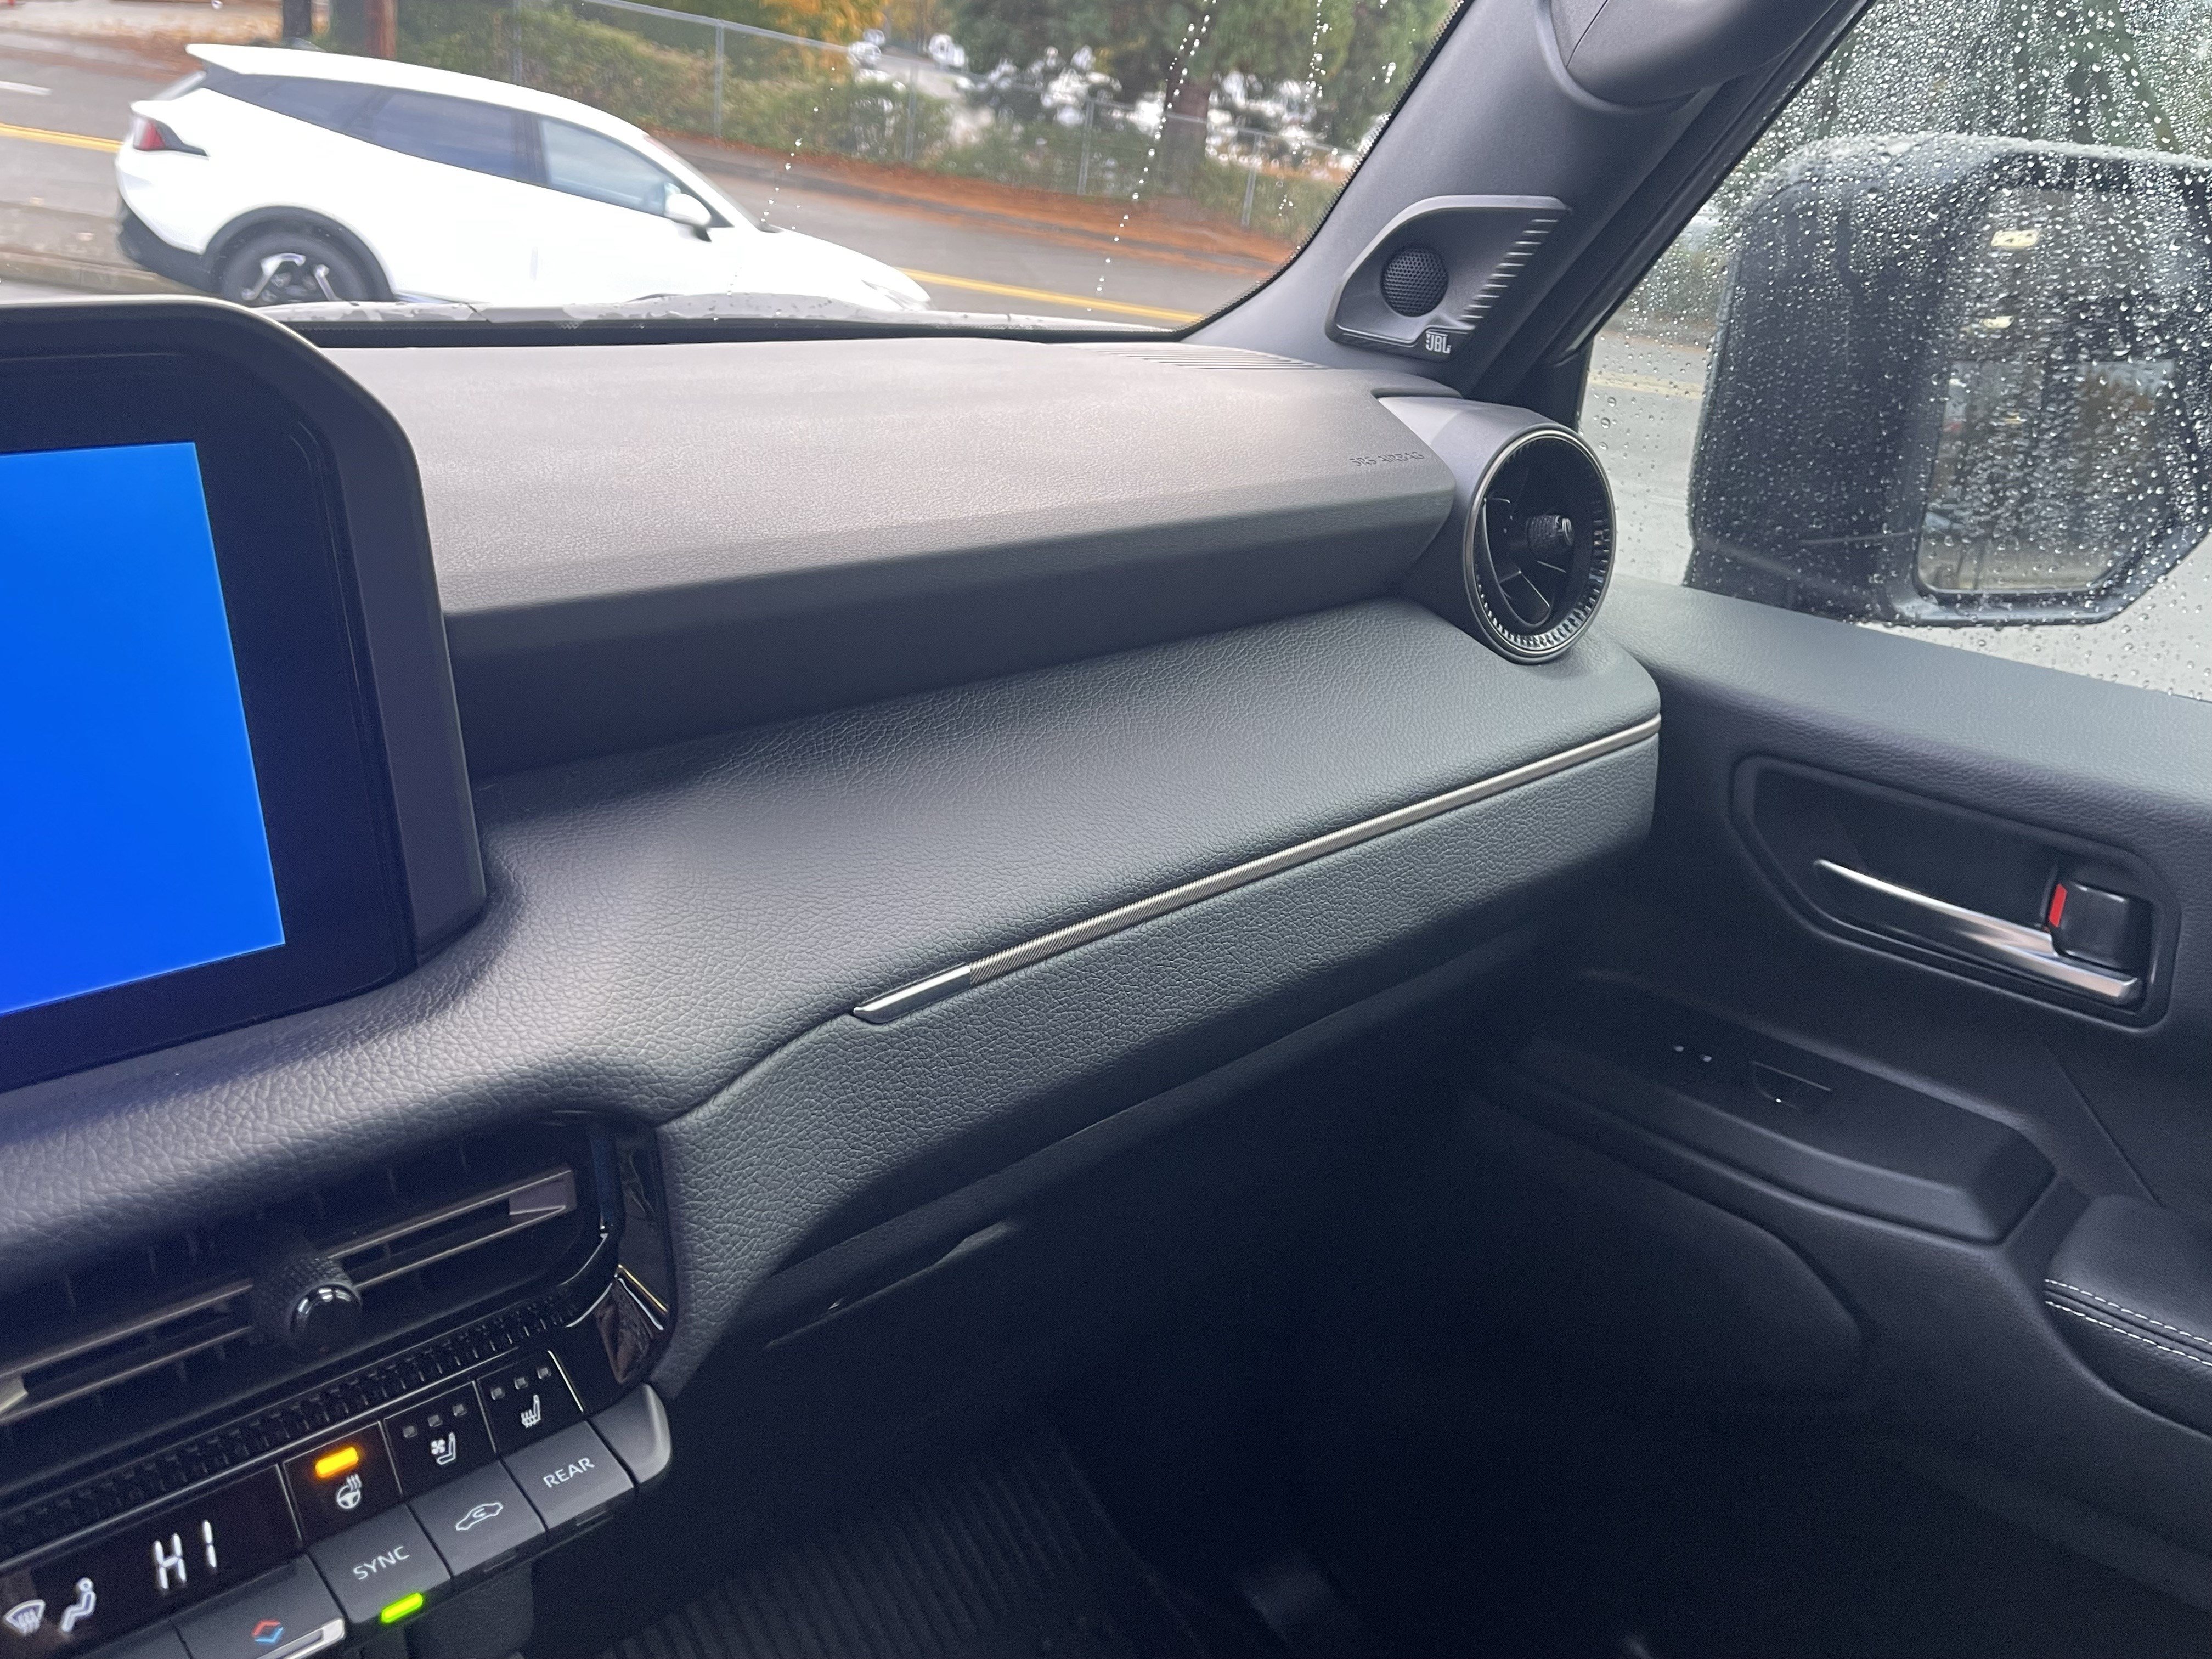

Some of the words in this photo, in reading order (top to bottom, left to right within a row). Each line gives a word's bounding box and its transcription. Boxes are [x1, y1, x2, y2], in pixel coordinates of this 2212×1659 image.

[1426, 333, 1451, 354] JBL
[1349, 456, 1377, 466] SRS
[1378, 452, 1425, 462] AIRBAG
[543, 1457, 595, 1488] REAR
[353, 1546, 409, 1580] SYNC
